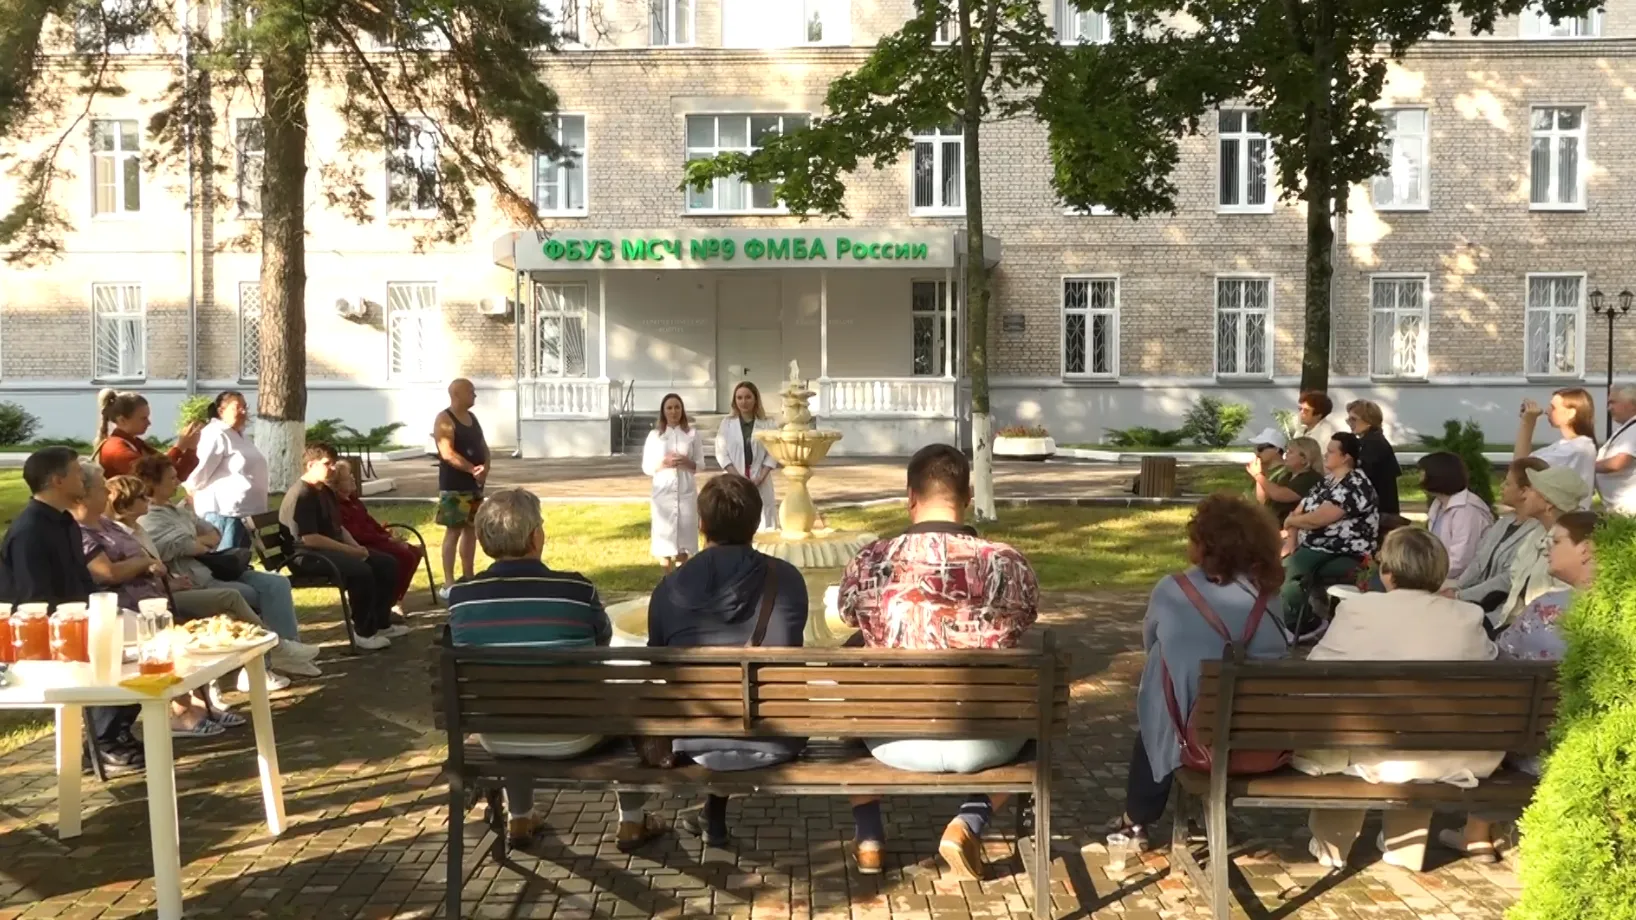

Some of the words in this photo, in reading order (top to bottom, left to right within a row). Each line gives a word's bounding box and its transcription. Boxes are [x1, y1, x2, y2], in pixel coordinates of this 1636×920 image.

[543, 239, 615, 261] ФБУЗ
[621, 239, 681, 261] МСЧ
[690, 239, 735, 260] №9
[744, 238, 827, 261] ФМБА
[836, 237, 928, 260] России
